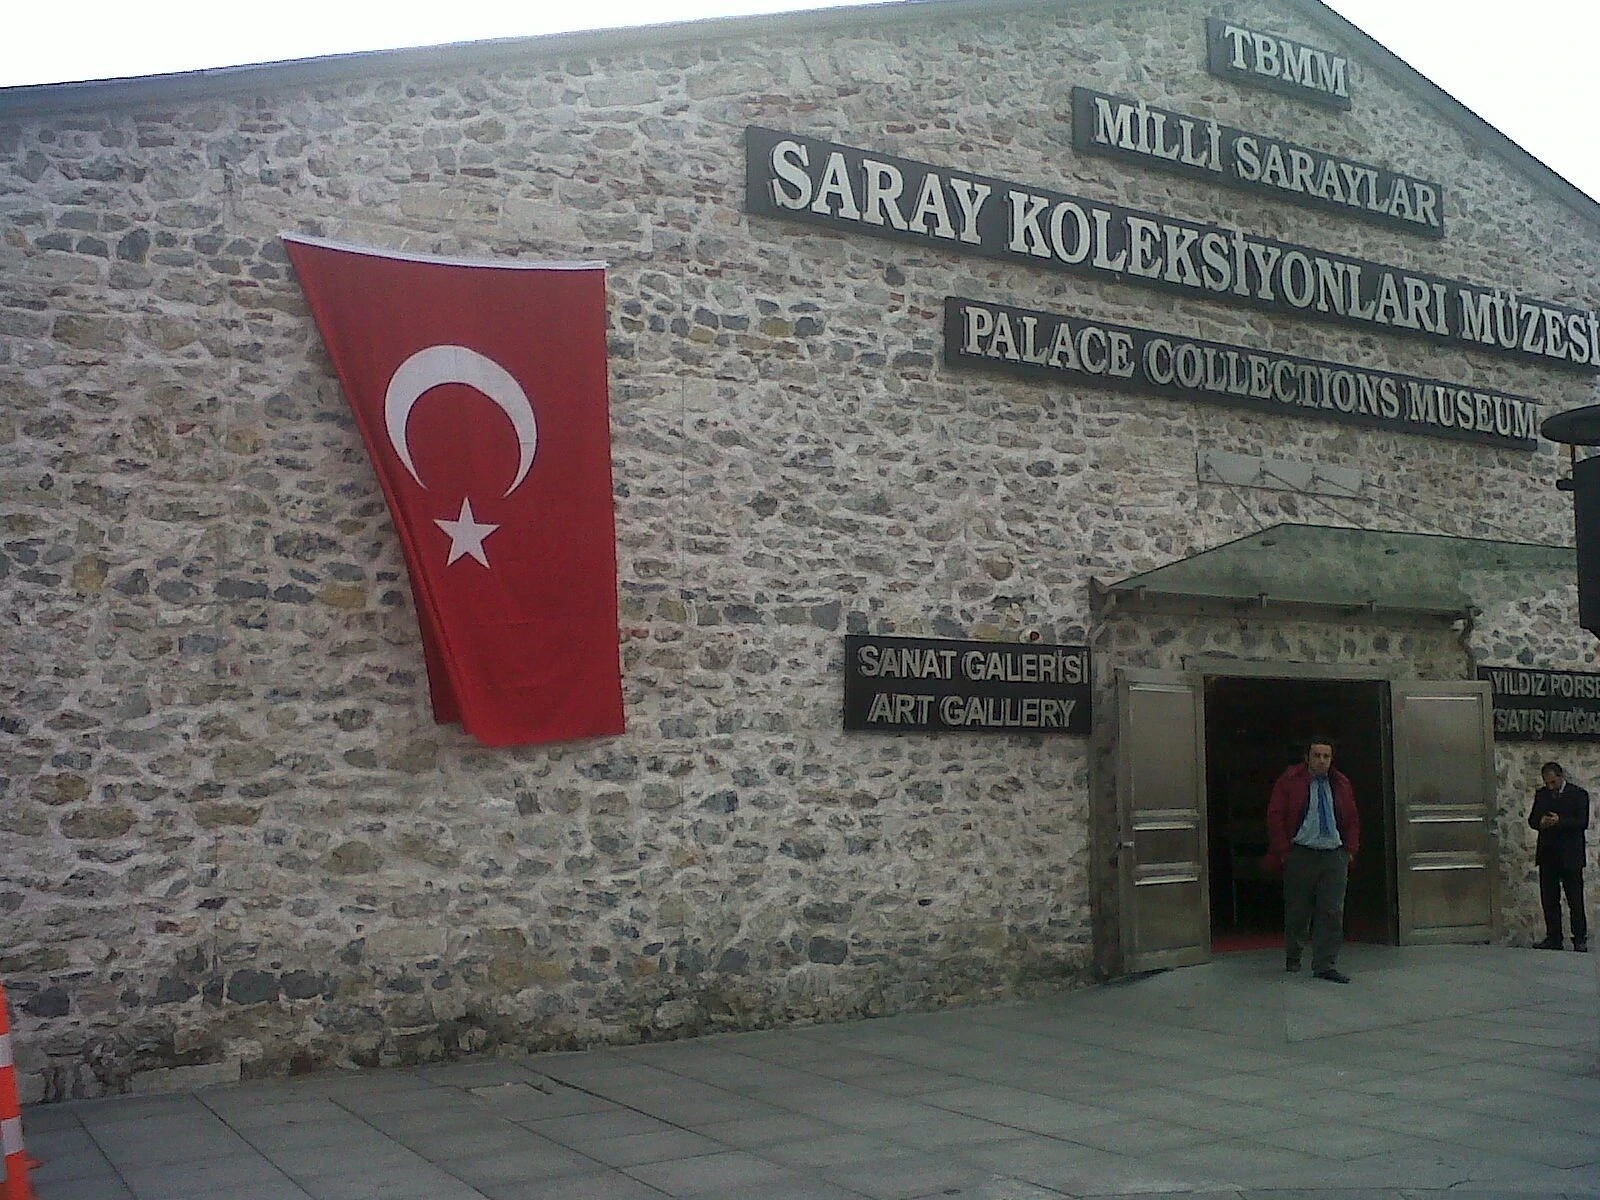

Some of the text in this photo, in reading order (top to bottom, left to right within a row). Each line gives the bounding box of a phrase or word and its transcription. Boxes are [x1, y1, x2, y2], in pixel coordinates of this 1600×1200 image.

[1224, 25, 1348, 98] TBMM
[1093, 97, 1441, 227] MİLLİ SARAYLAR
[770, 139, 1600, 367] SARAY KOLEKSİYONLARI MÜZESİ
[960, 305, 1538, 440] PALACE COLLECTIONS MUSEUM
[858, 645, 957, 680] SANAT
[1489, 671, 1547, 697] YILDIZ
[867, 693, 1077, 728] ART GALLERY
[1494, 708, 1546, 740] SATIŞ
